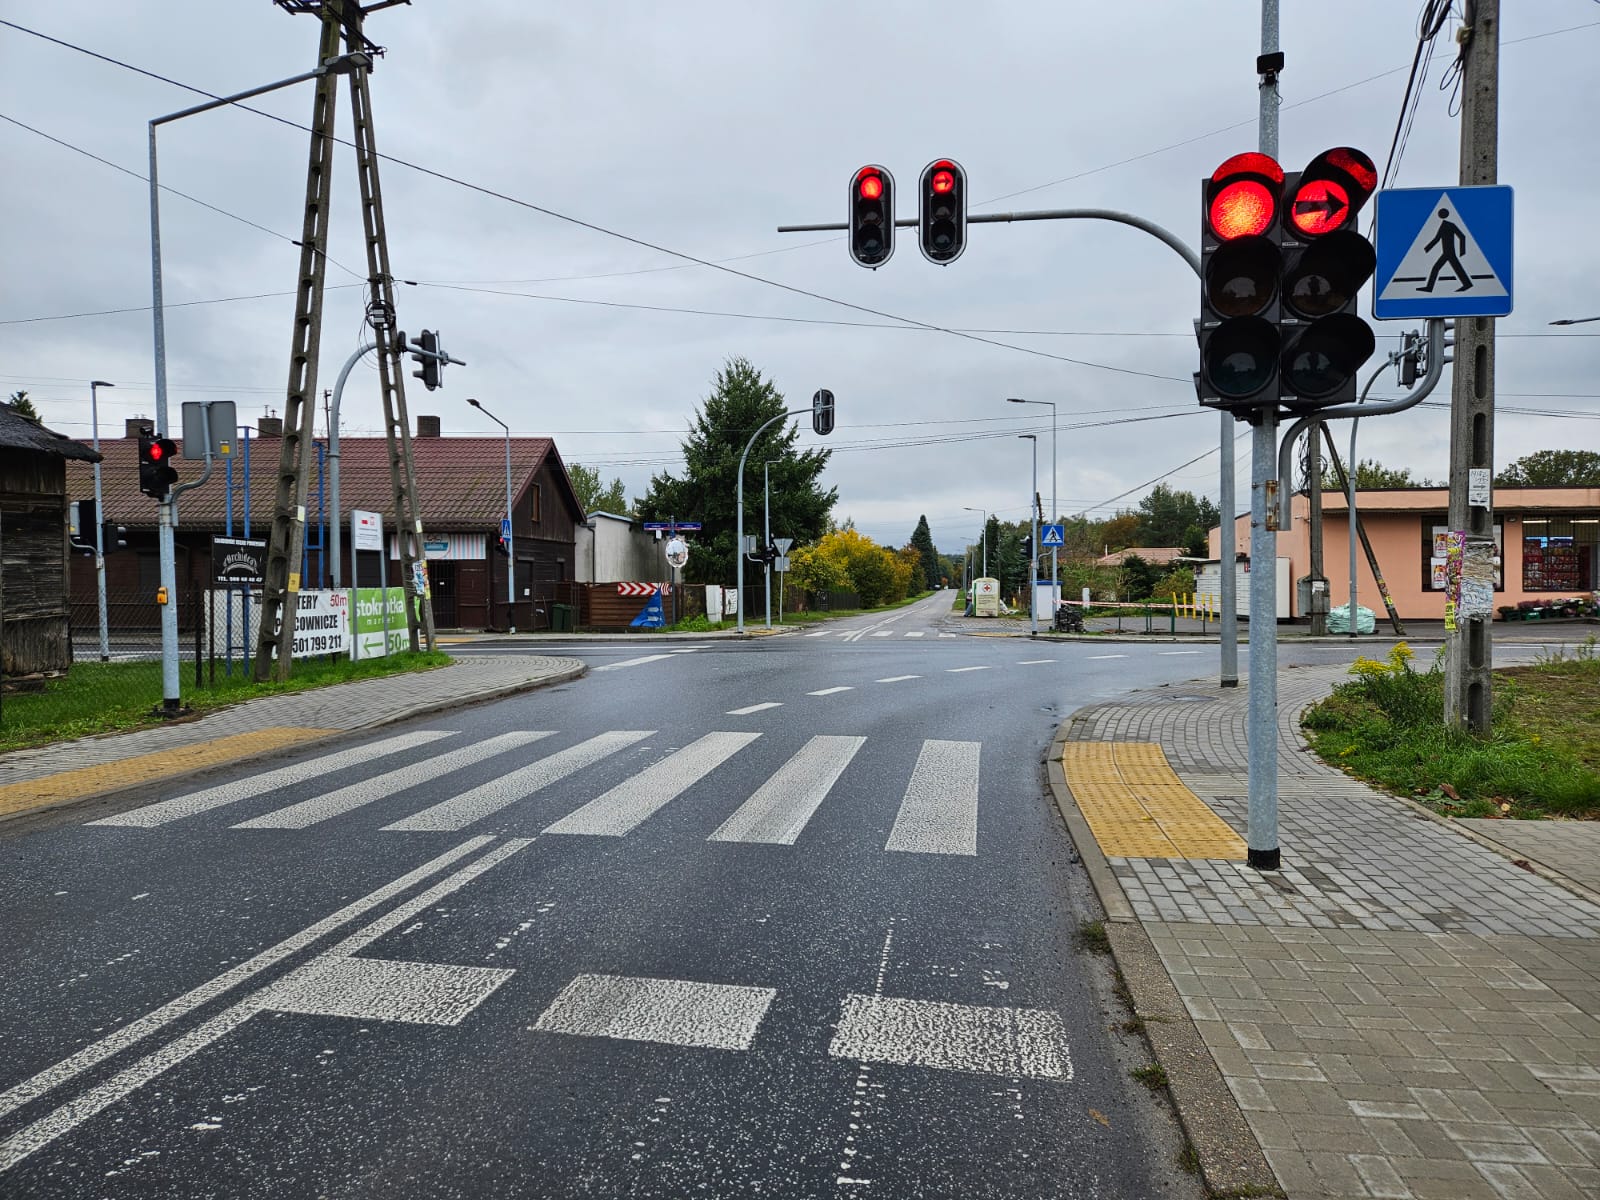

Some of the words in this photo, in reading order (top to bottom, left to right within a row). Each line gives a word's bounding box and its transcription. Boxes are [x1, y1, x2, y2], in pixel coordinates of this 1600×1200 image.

[274, 615, 338, 633] PCOWNICZE
[292, 637, 309, 653] 501
[310, 636, 327, 651] 799
[328, 634, 342, 649] 211
